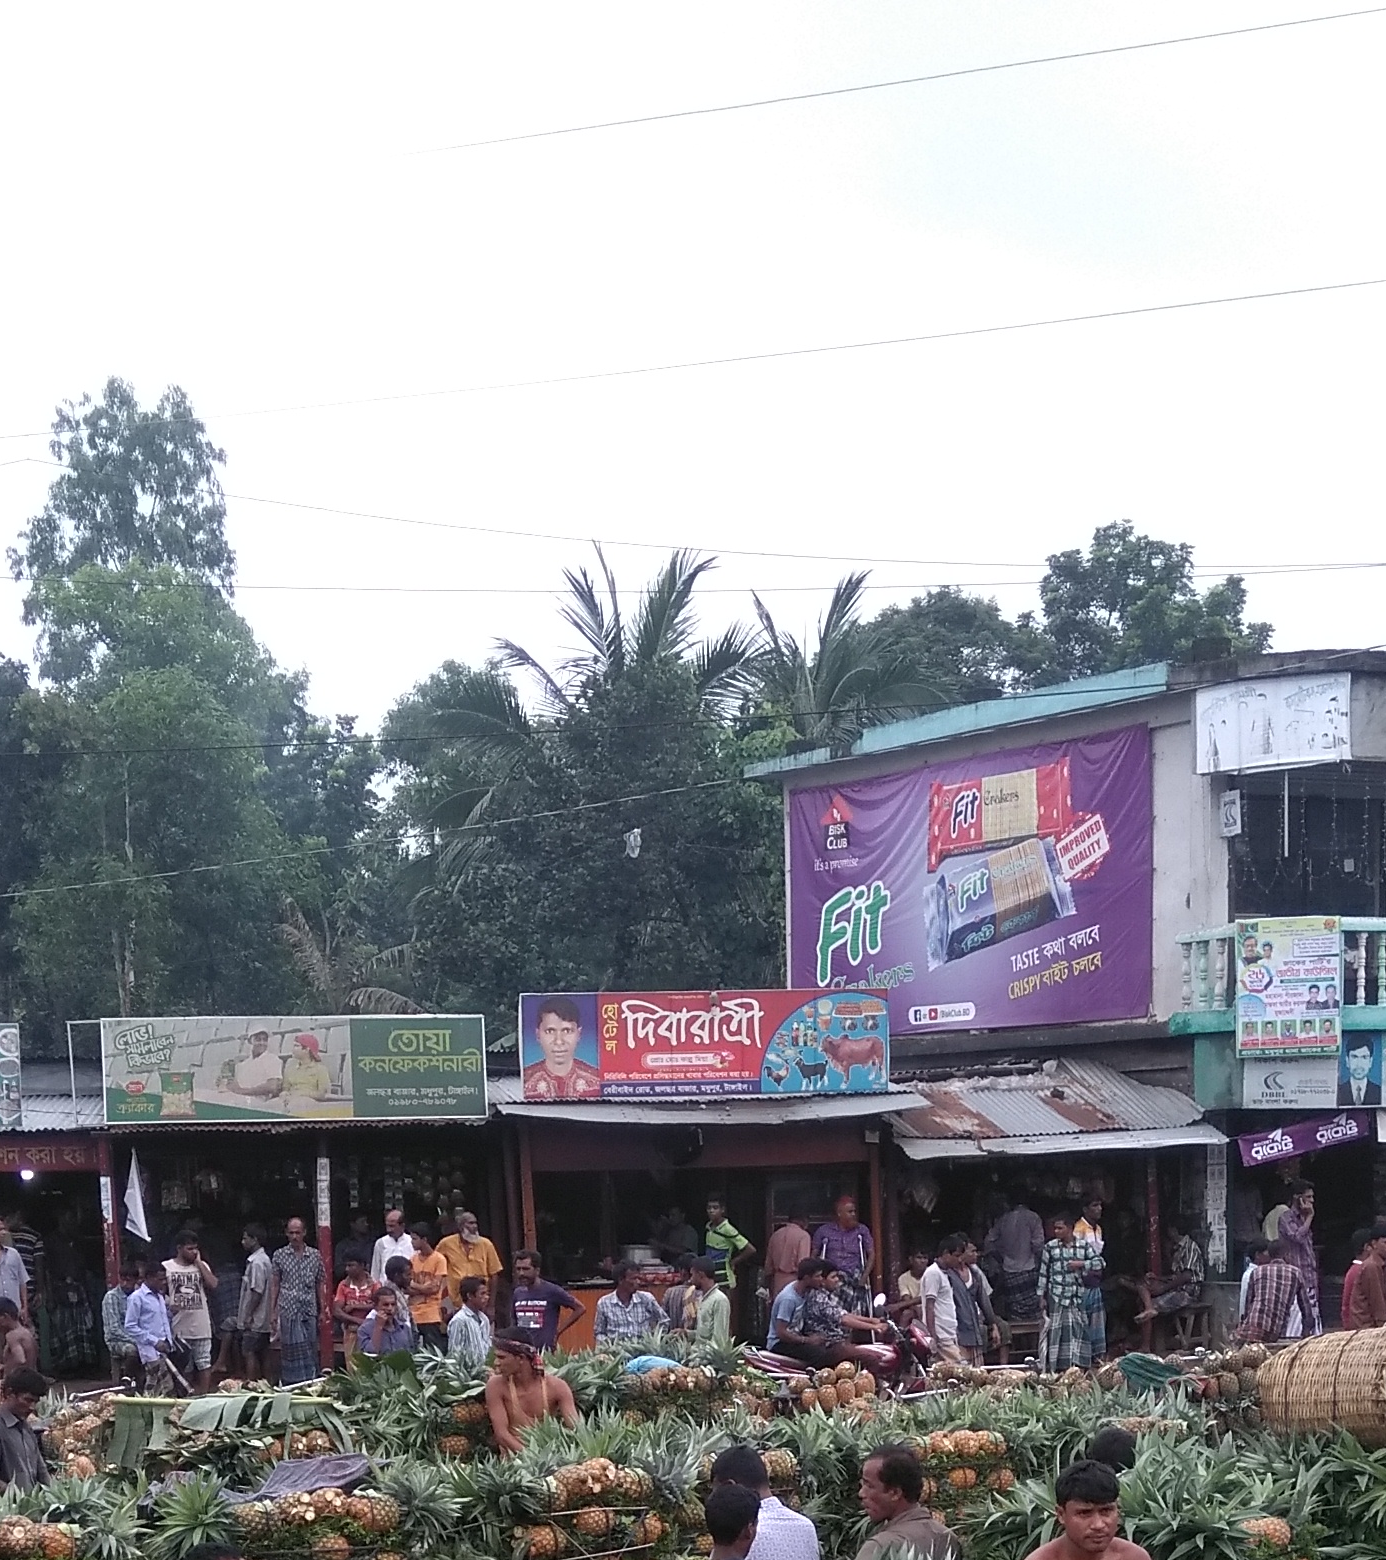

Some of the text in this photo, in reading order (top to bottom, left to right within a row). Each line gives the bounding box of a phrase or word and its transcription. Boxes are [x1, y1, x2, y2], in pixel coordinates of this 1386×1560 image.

[951, 788, 980, 839] Fit
[827, 836, 848, 849] CLUB
[1058, 819, 1102, 857] IMPROVED
[1067, 839, 1102, 871] QUALITY
[957, 867, 989, 913] Fit
[817, 881, 890, 986] Fit
[1010, 925, 1100, 973] TASTE কথা বলবে
[1008, 972, 1041, 1000] CRISPY
[1072, 951, 1102, 977] চলবে
[357, 1048, 482, 1073] কনফেকশনারী
[388, 1029, 452, 1055] তোয়া
[25, 1147, 56, 1166] করা
